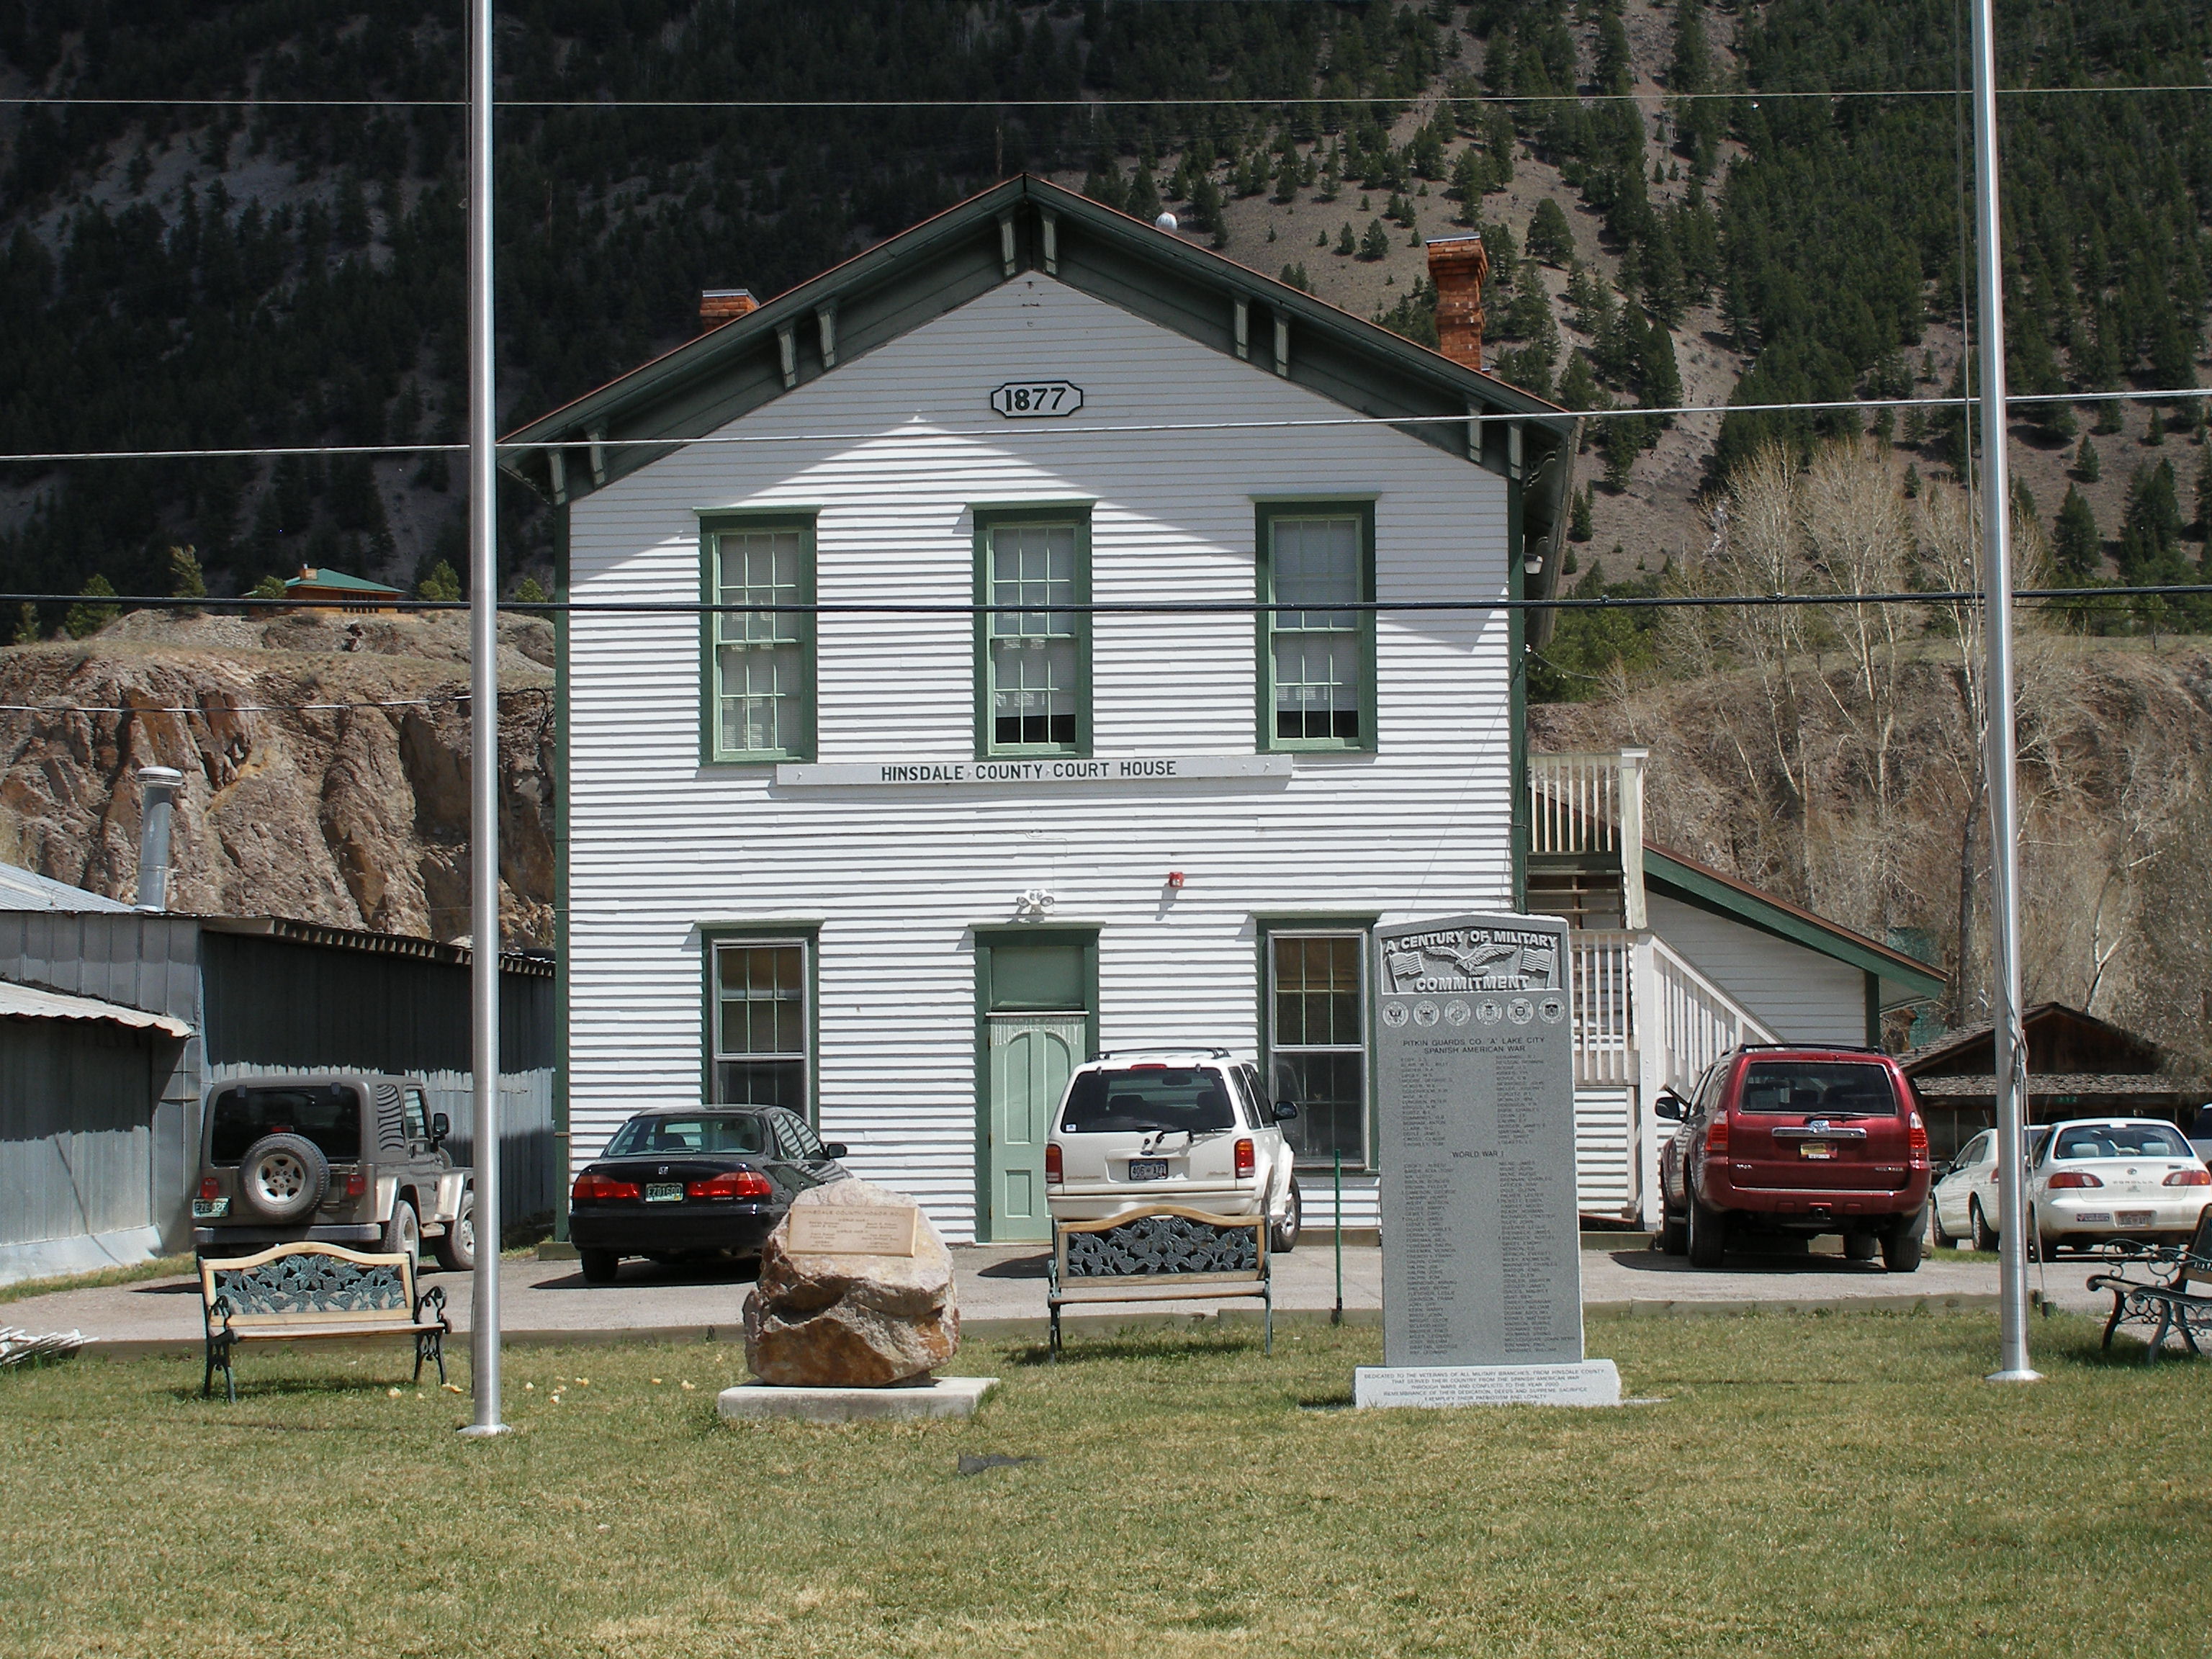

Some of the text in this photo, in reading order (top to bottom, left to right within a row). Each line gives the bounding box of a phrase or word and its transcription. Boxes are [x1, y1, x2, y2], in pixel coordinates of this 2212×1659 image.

[1004, 387, 1066, 411] 1877
[881, 760, 1177, 781] HINSDALE COUNTY COURT HOUSE
[1385, 930, 1558, 953] A CENTURY OF MILITARY
[1416, 974, 1530, 992] COMMITMENT
[1044, 1017, 1079, 1045] COUNTY
